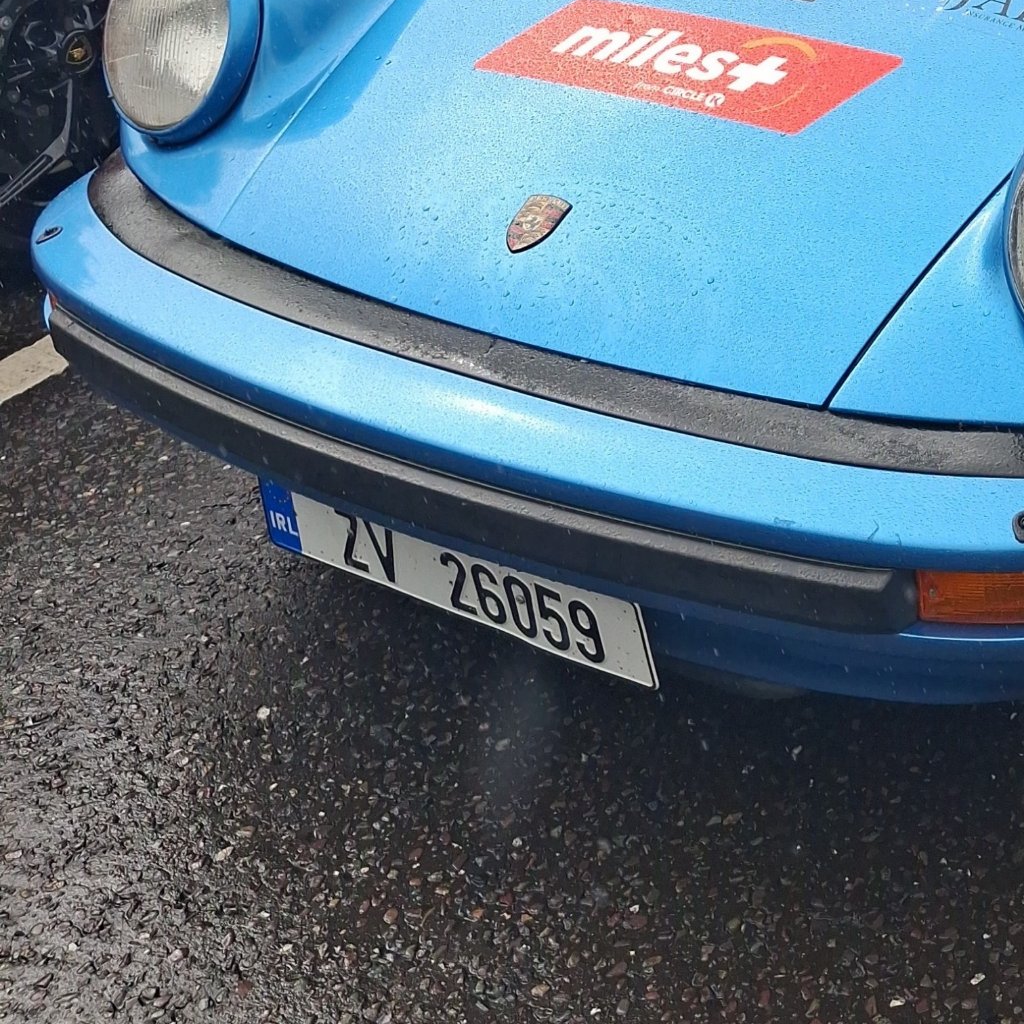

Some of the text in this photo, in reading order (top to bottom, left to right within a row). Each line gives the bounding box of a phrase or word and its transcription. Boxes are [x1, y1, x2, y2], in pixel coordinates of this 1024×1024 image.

[552, 24, 789, 92] miles+
[662, 85, 708, 102] CIRCLE
[269, 508, 299, 537] IRL
[334, 508, 606, 664] ZV 26059
